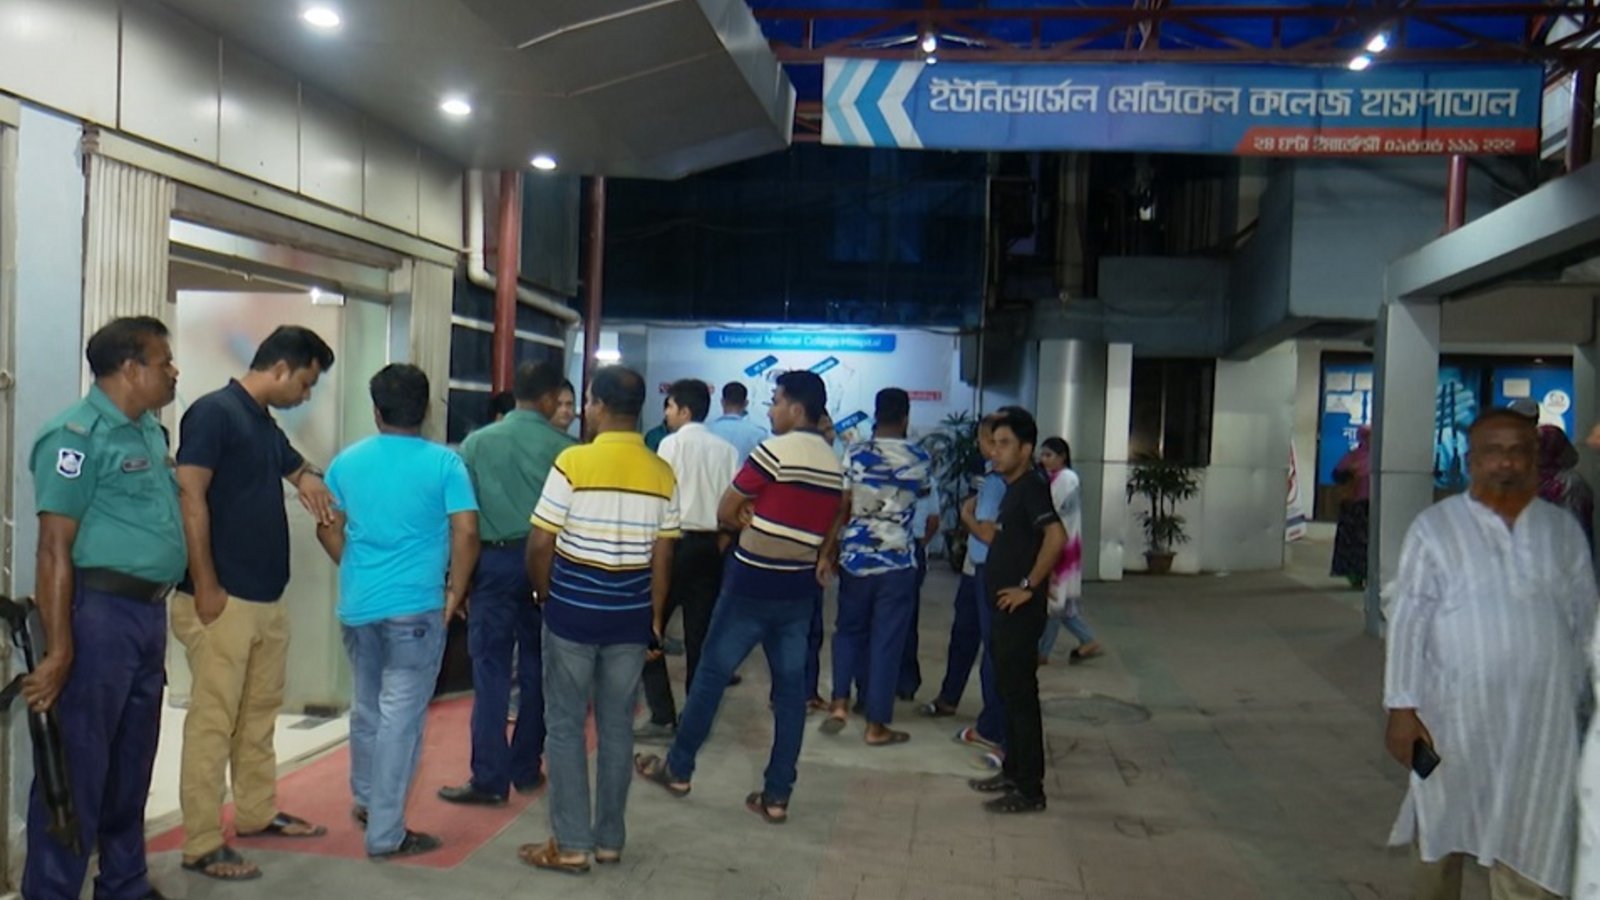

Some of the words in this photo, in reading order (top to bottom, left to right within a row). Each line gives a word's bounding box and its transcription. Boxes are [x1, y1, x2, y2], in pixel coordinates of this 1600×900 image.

[929, 77, 1099, 113] ইউনিভার্সেল
[1108, 82, 1241, 115] মেডিকেল
[1249, 88, 1353, 116] কলেজ
[1361, 88, 1520, 117] হাসপাতাল
[719, 335, 762, 345] Universal
[763, 335, 801, 345] Medical
[803, 335, 840, 348] College
[841, 336, 882, 348] Hospital
